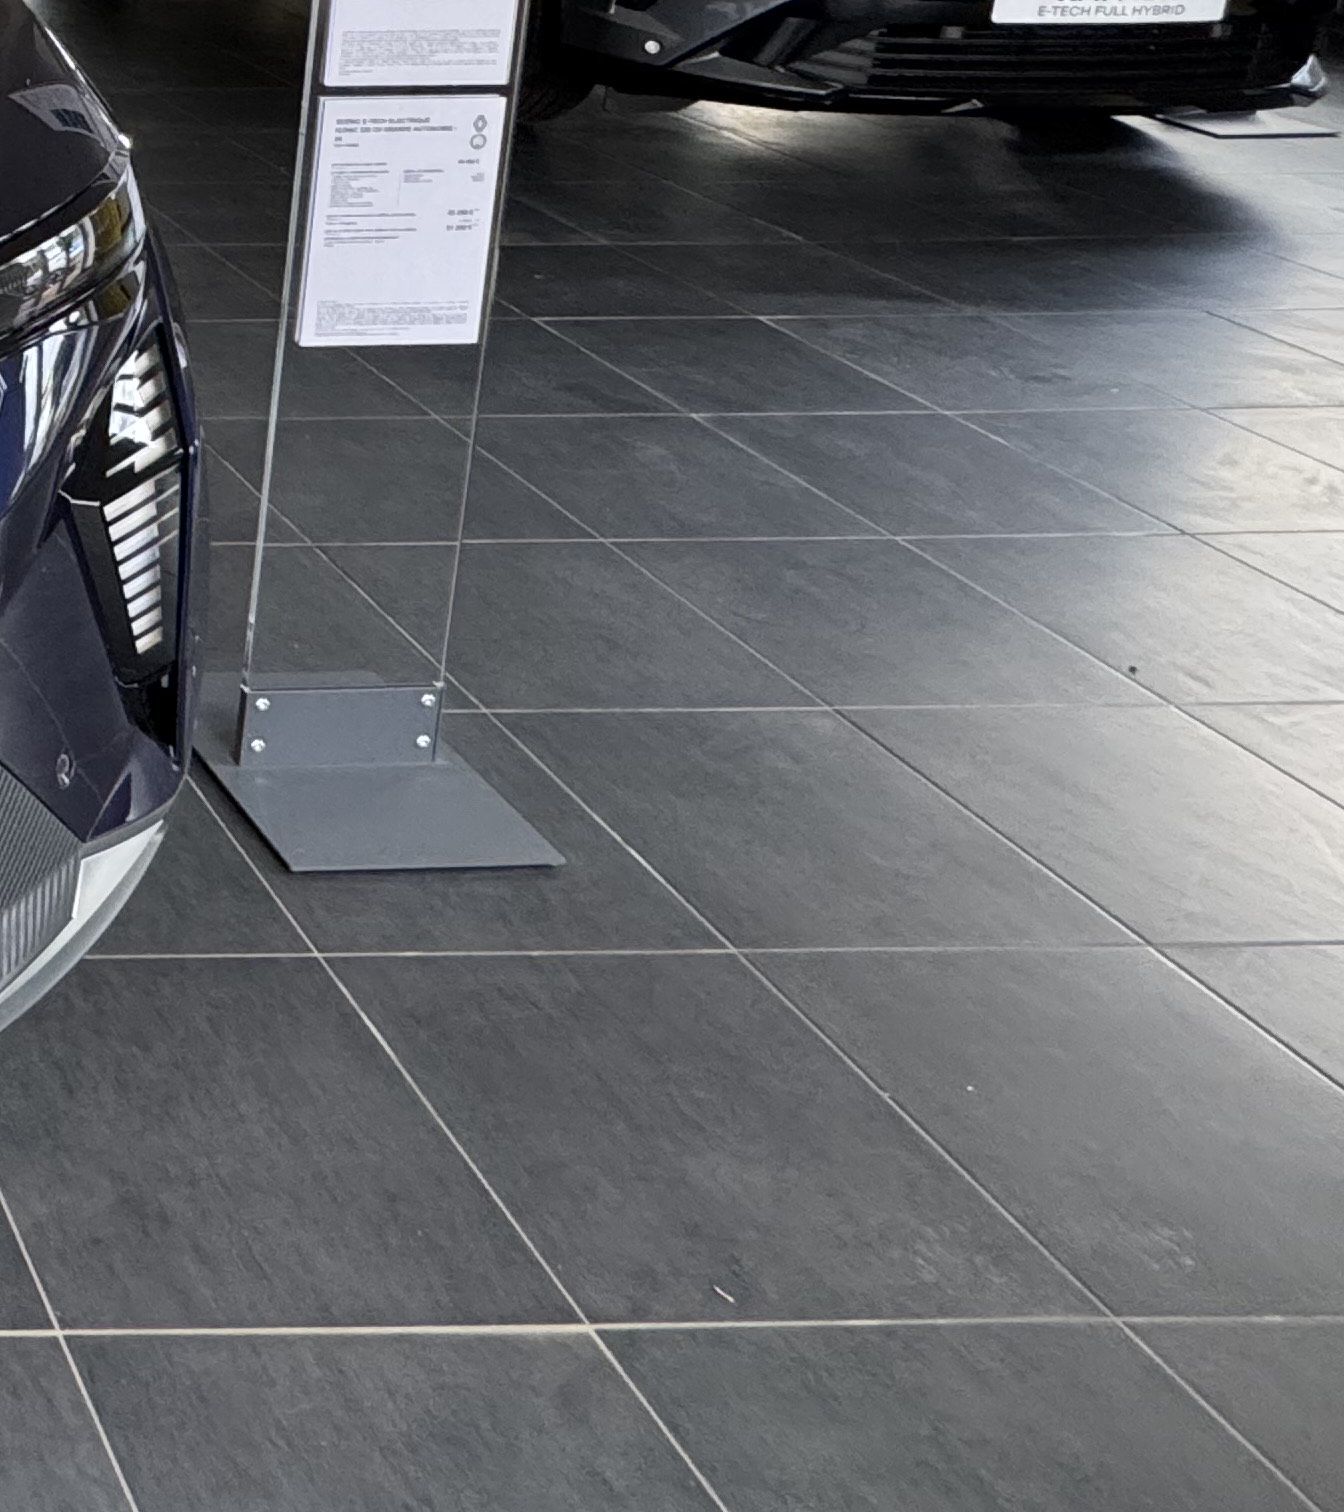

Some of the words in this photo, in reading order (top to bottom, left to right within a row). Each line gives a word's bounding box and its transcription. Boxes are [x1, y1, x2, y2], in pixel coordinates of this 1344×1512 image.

[1037, 5, 1091, 17] E-TECH
[1094, 5, 1129, 17] FULL
[1132, 4, 1186, 16] HYBRID
